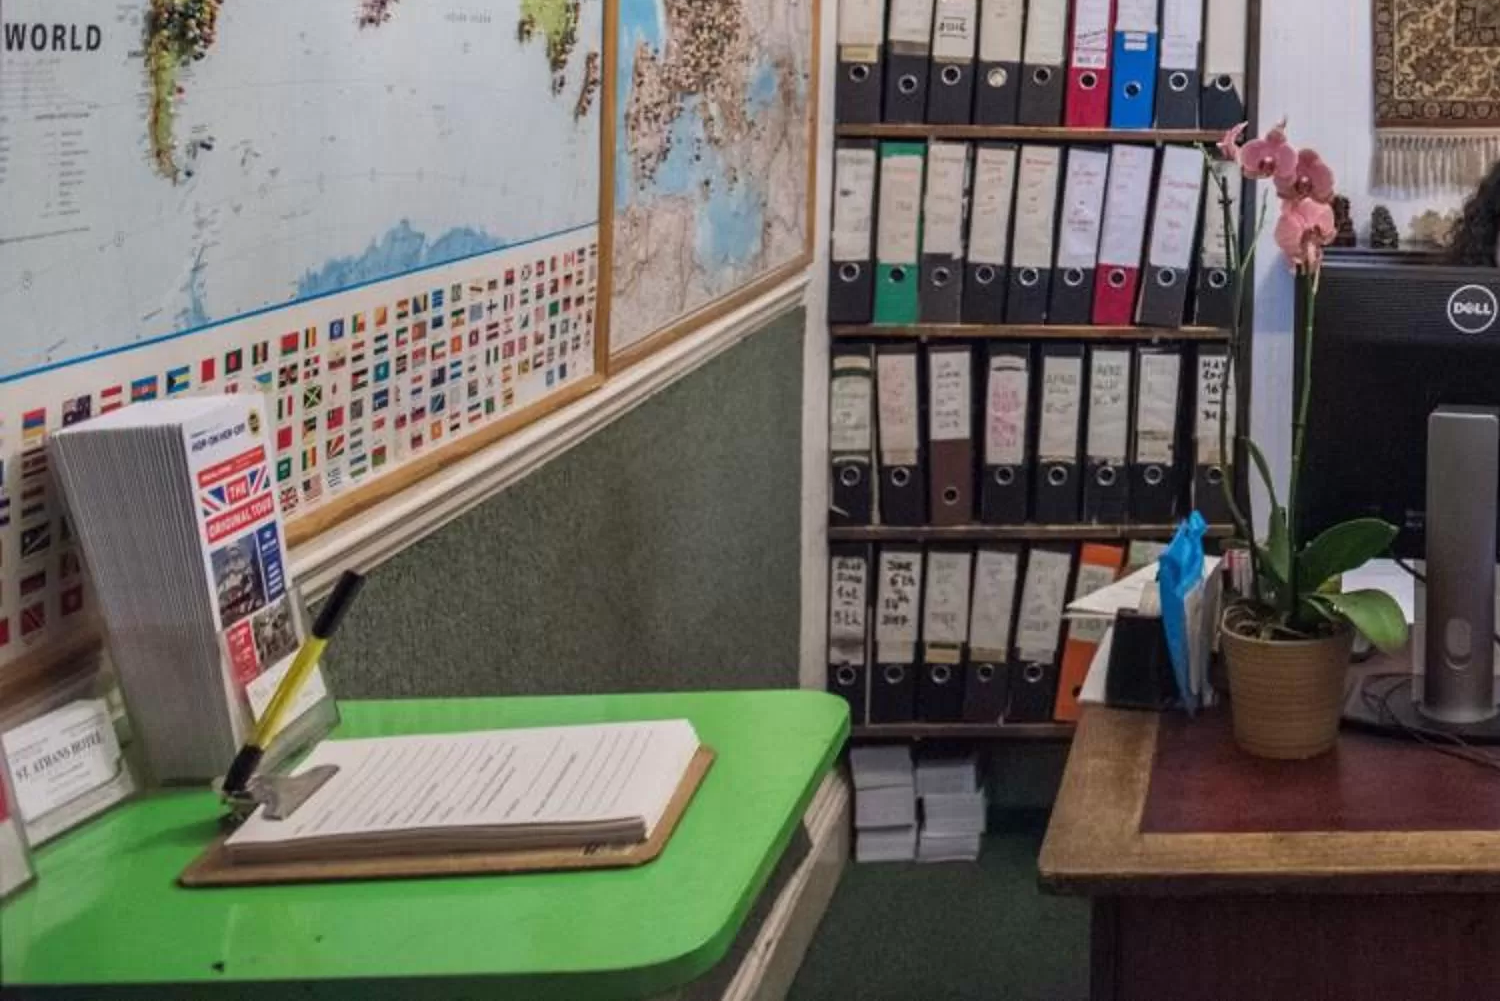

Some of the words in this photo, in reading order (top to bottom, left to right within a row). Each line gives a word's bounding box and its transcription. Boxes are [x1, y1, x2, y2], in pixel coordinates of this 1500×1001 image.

[4, 22, 102, 52] WORLD
[1453, 302, 1492, 315] DELL
[230, 481, 247, 499] THE
[33, 746, 71, 774] ATHANS
